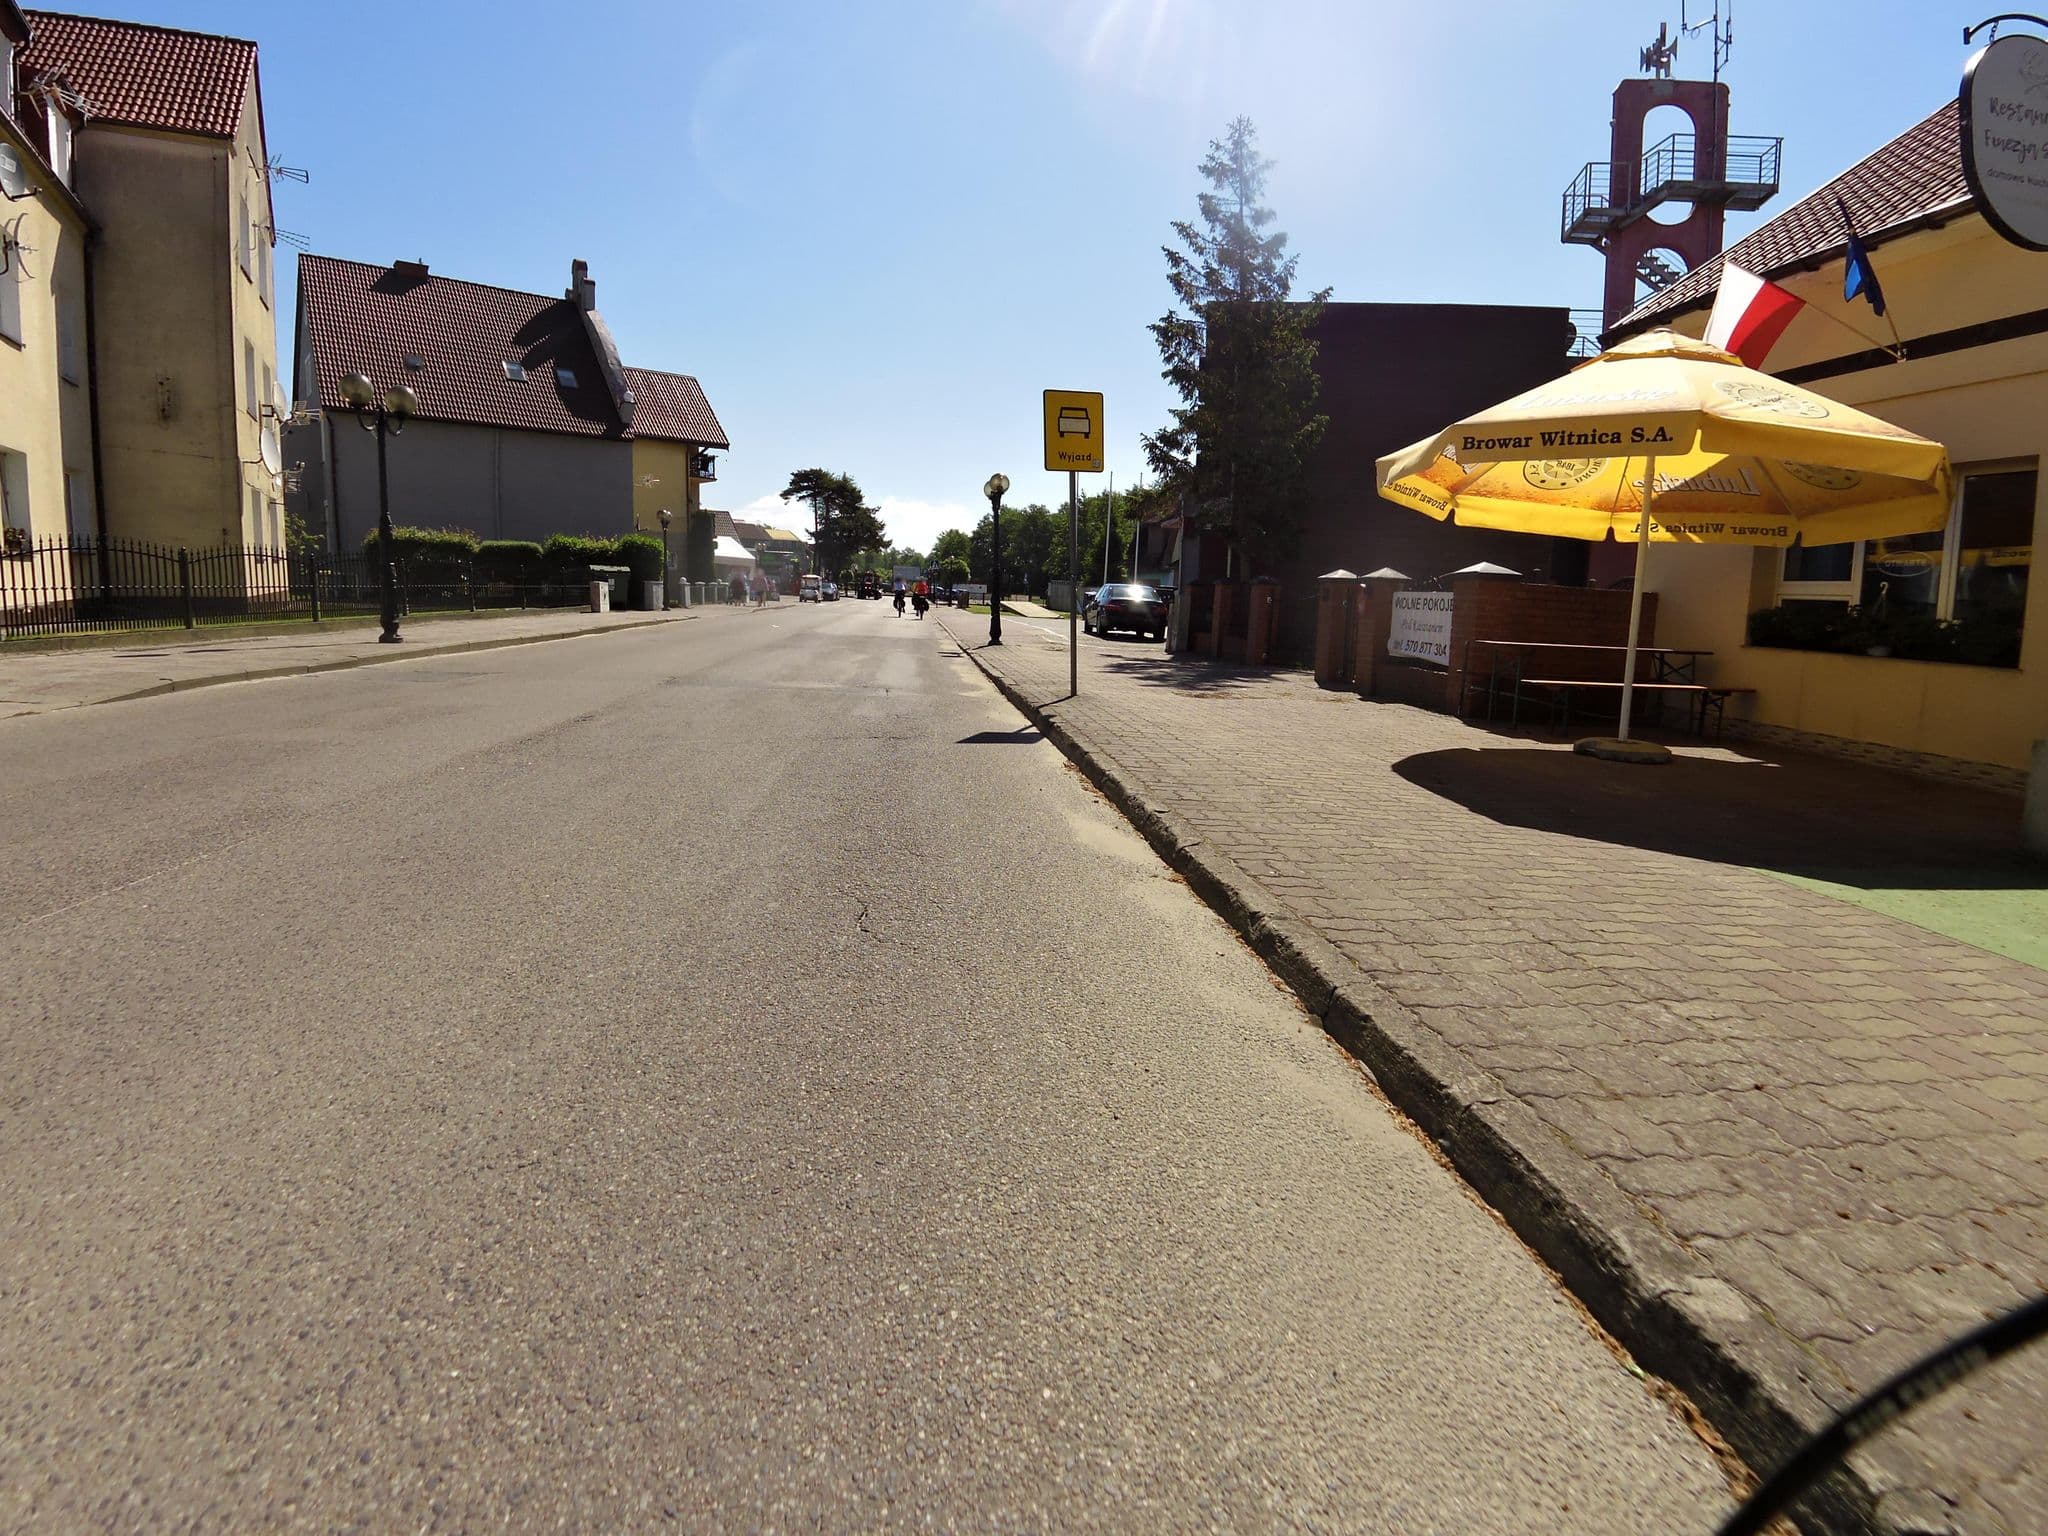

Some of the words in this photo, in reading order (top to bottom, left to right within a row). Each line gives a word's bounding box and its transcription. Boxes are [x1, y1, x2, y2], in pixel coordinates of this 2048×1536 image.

[1461, 432, 1534, 451] Browar
[1540, 428, 1622, 447] Witnica
[1630, 425, 1674, 444] S.A.
[1058, 451, 1092, 463] Wyjazd
[1395, 596, 1422, 610] WOLNE
[1423, 598, 1453, 612] POKOJE
[1404, 640, 1418, 653] 570
[1419, 642, 1433, 655] 877
